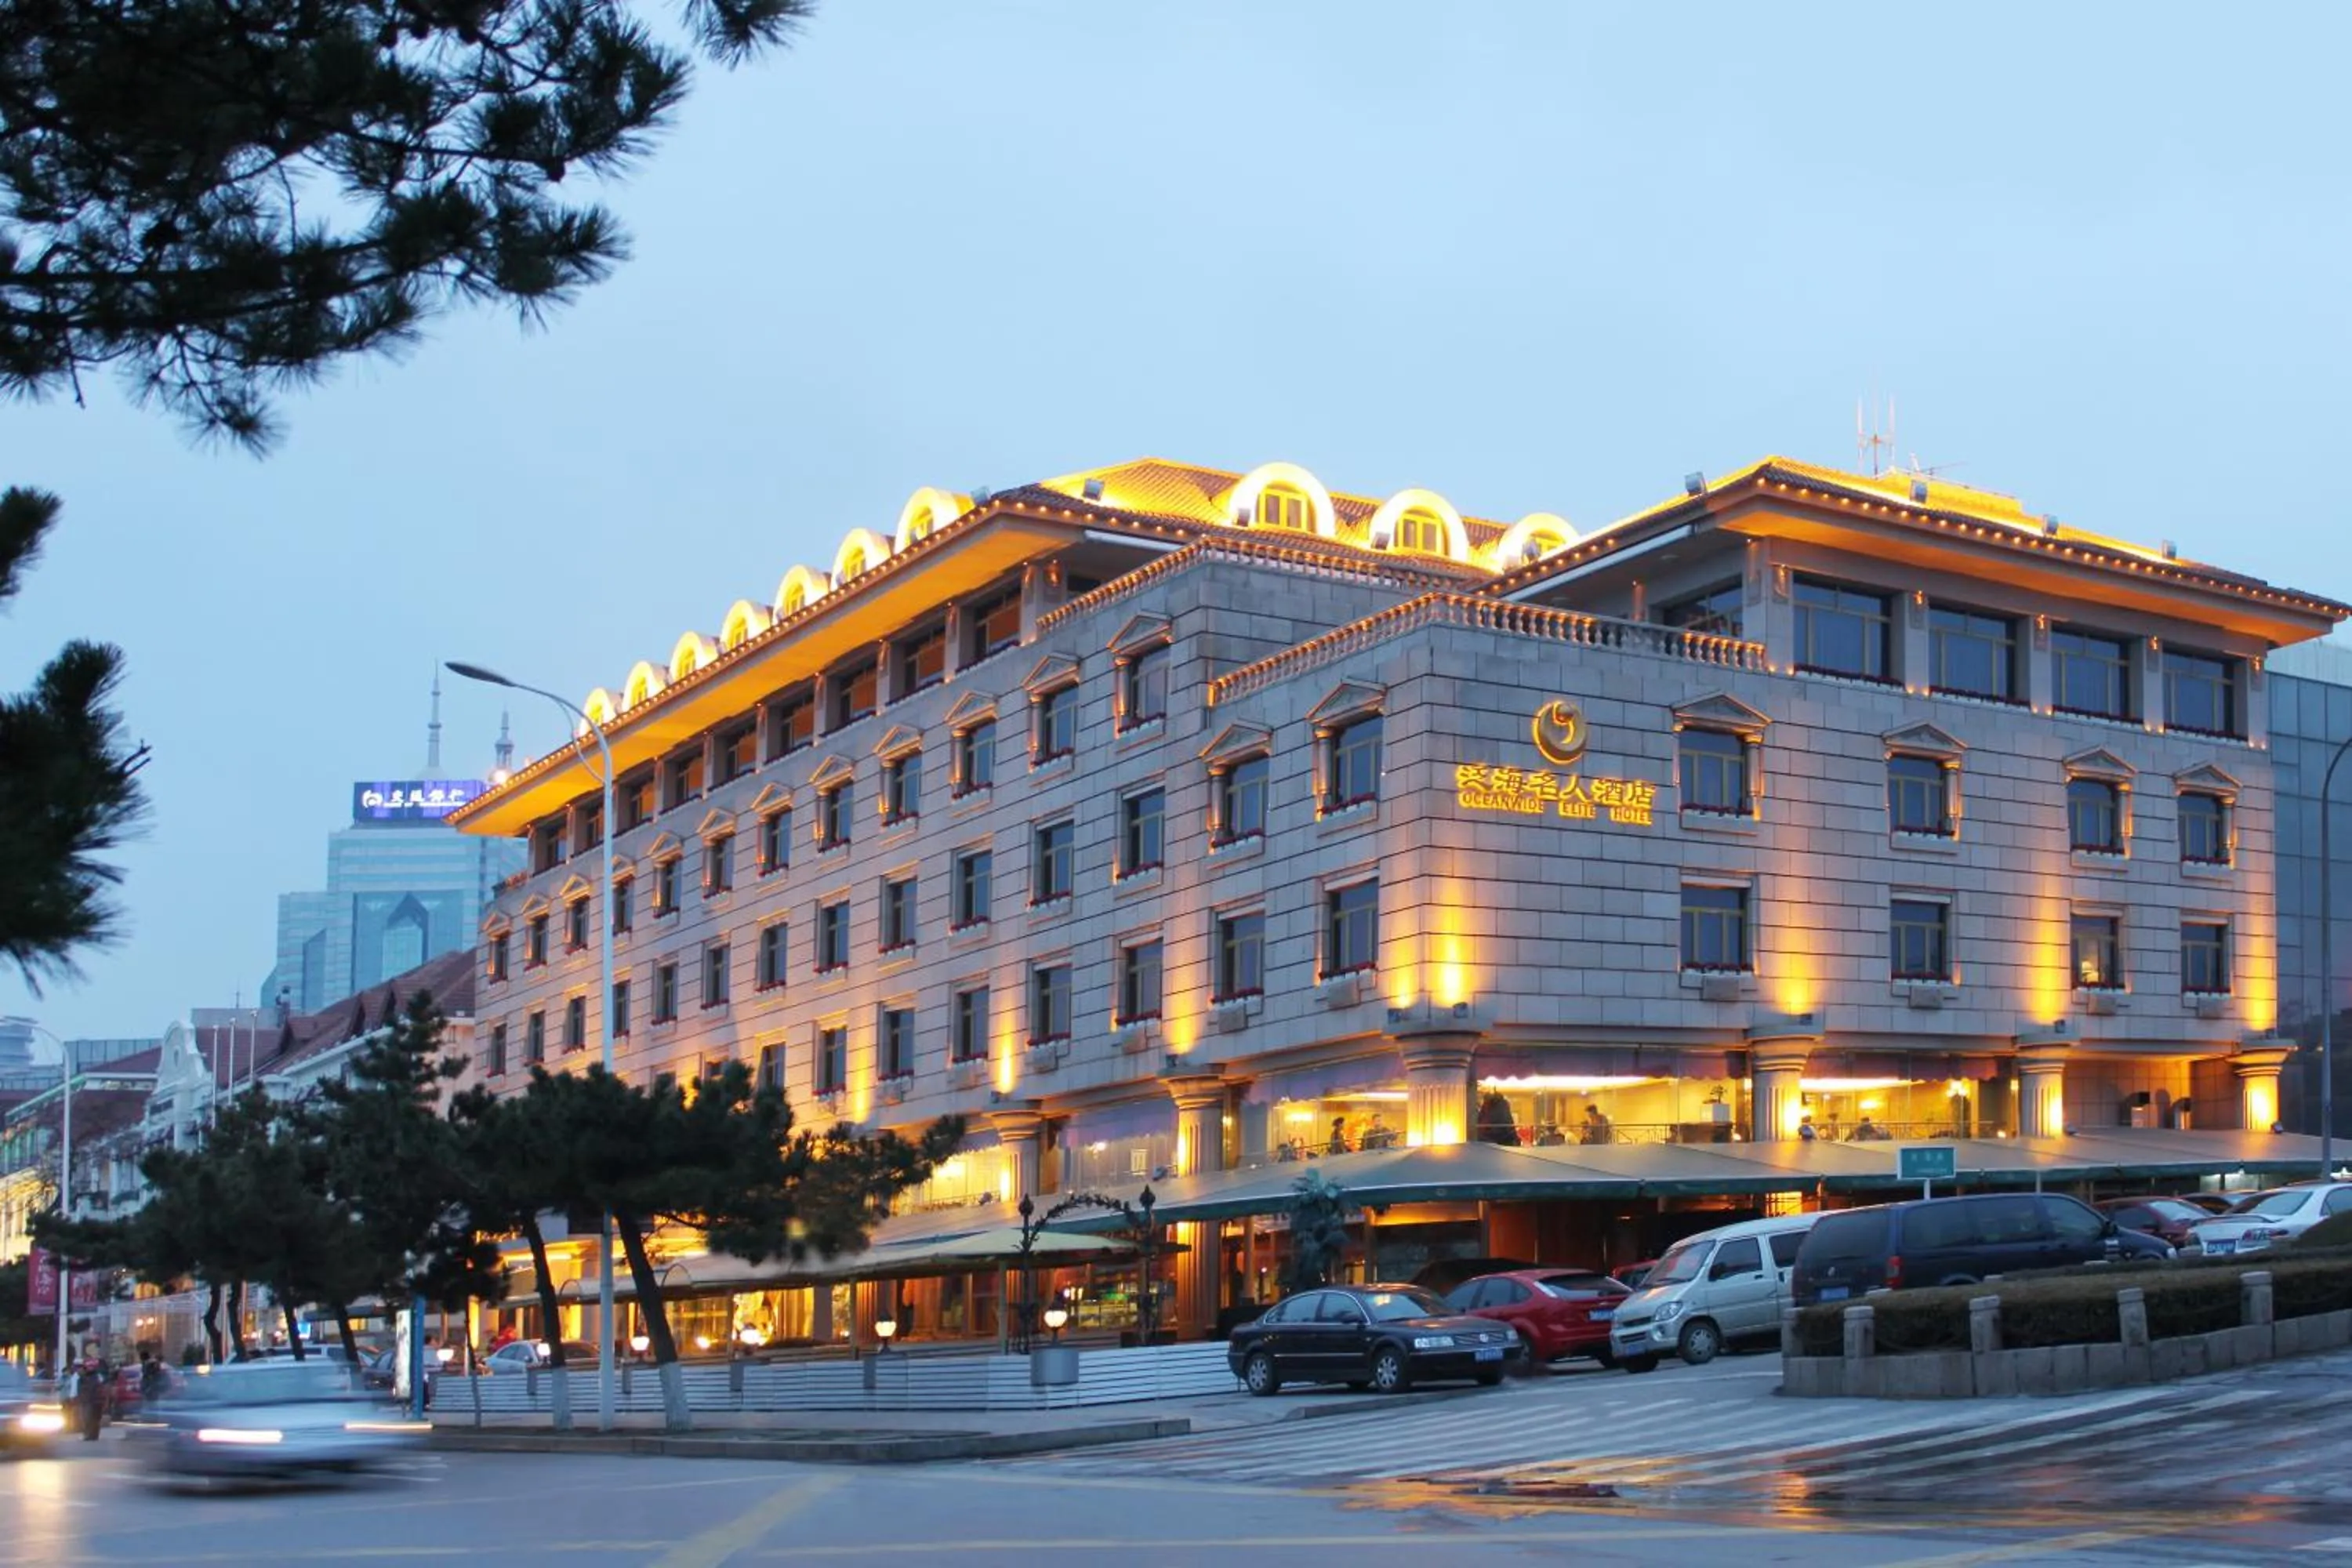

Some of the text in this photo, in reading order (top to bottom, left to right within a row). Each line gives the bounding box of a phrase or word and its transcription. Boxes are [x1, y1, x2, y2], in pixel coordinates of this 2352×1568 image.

[1459, 791, 1653, 825] OCEANWIDE ELITE HOTEL
